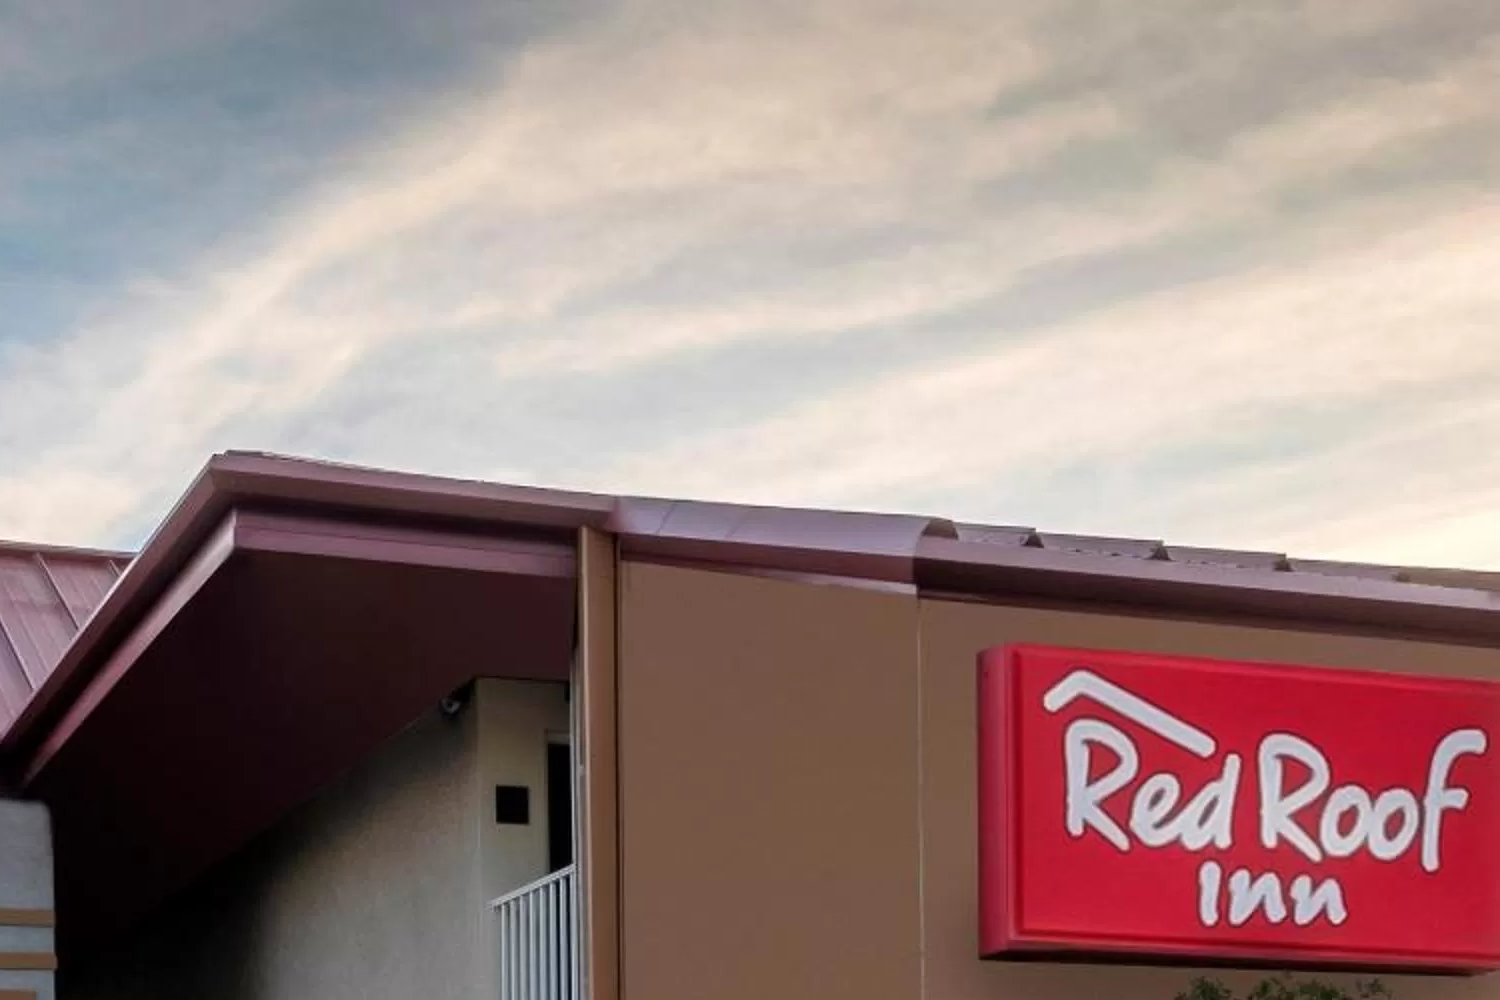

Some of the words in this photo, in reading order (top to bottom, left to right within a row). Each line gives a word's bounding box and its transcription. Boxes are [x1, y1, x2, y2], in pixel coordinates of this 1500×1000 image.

[1063, 718, 1242, 852] Red
[1257, 729, 1489, 873] Roof
[1198, 860, 1348, 927] Inn
